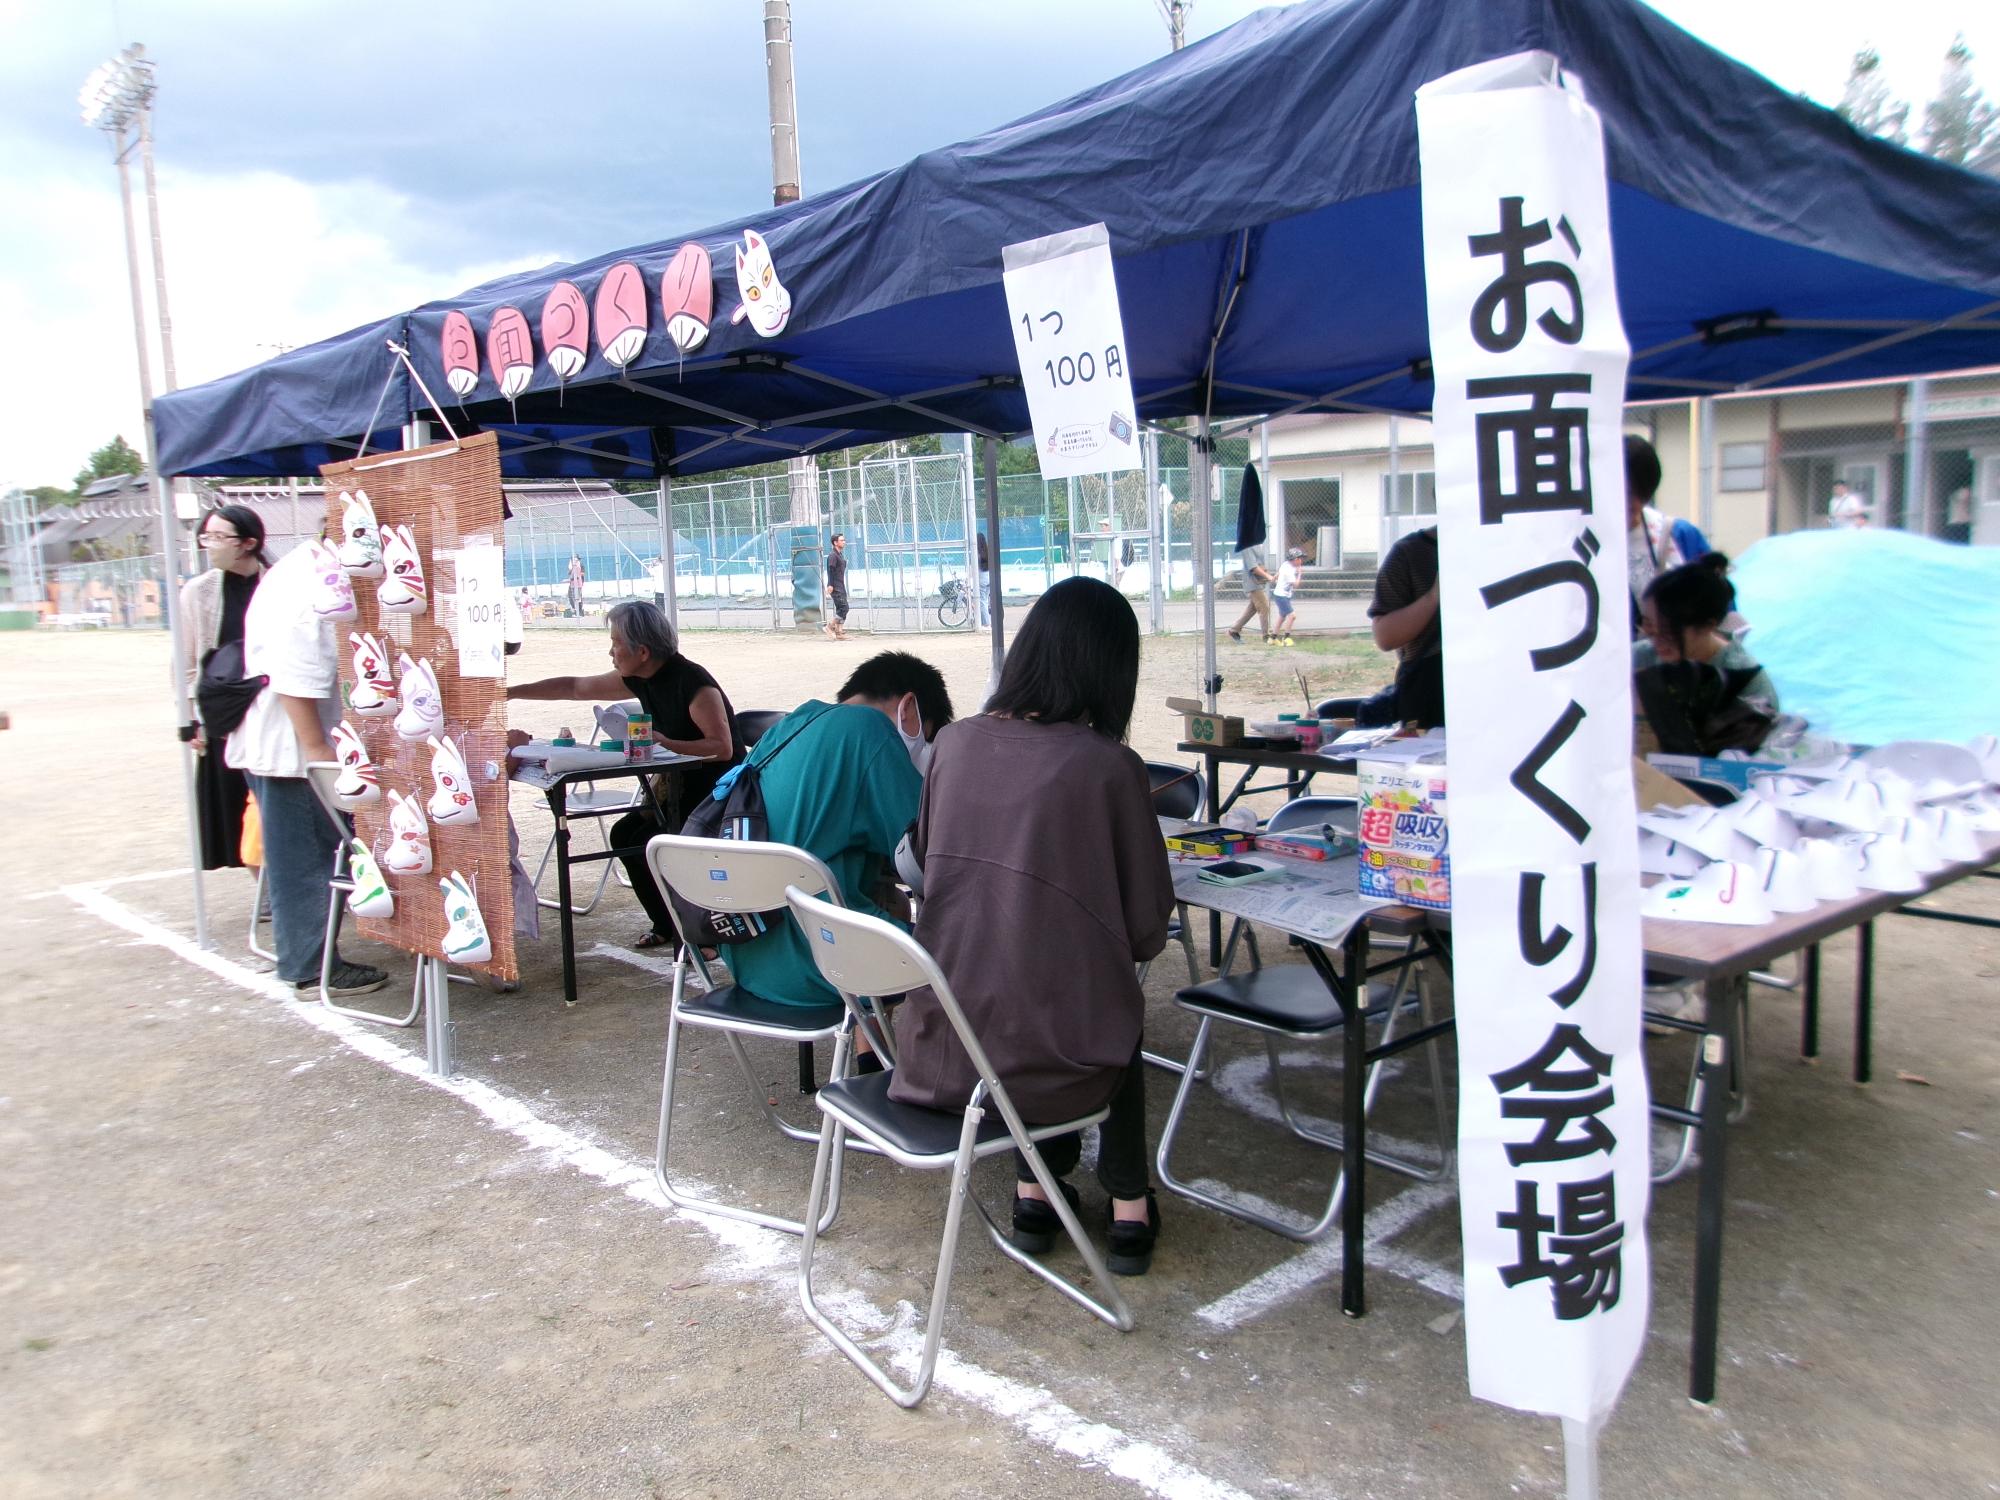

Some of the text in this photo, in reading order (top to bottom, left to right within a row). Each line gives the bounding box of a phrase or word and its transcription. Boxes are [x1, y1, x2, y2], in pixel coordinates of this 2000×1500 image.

[1022, 310, 1063, 342] 1つ
[1045, 344, 1122, 388] 100円
[461, 576, 478, 593] 1つ
[1466, 195, 1625, 1322] お面づくり会場
[1377, 775, 1423, 788] エリエール
